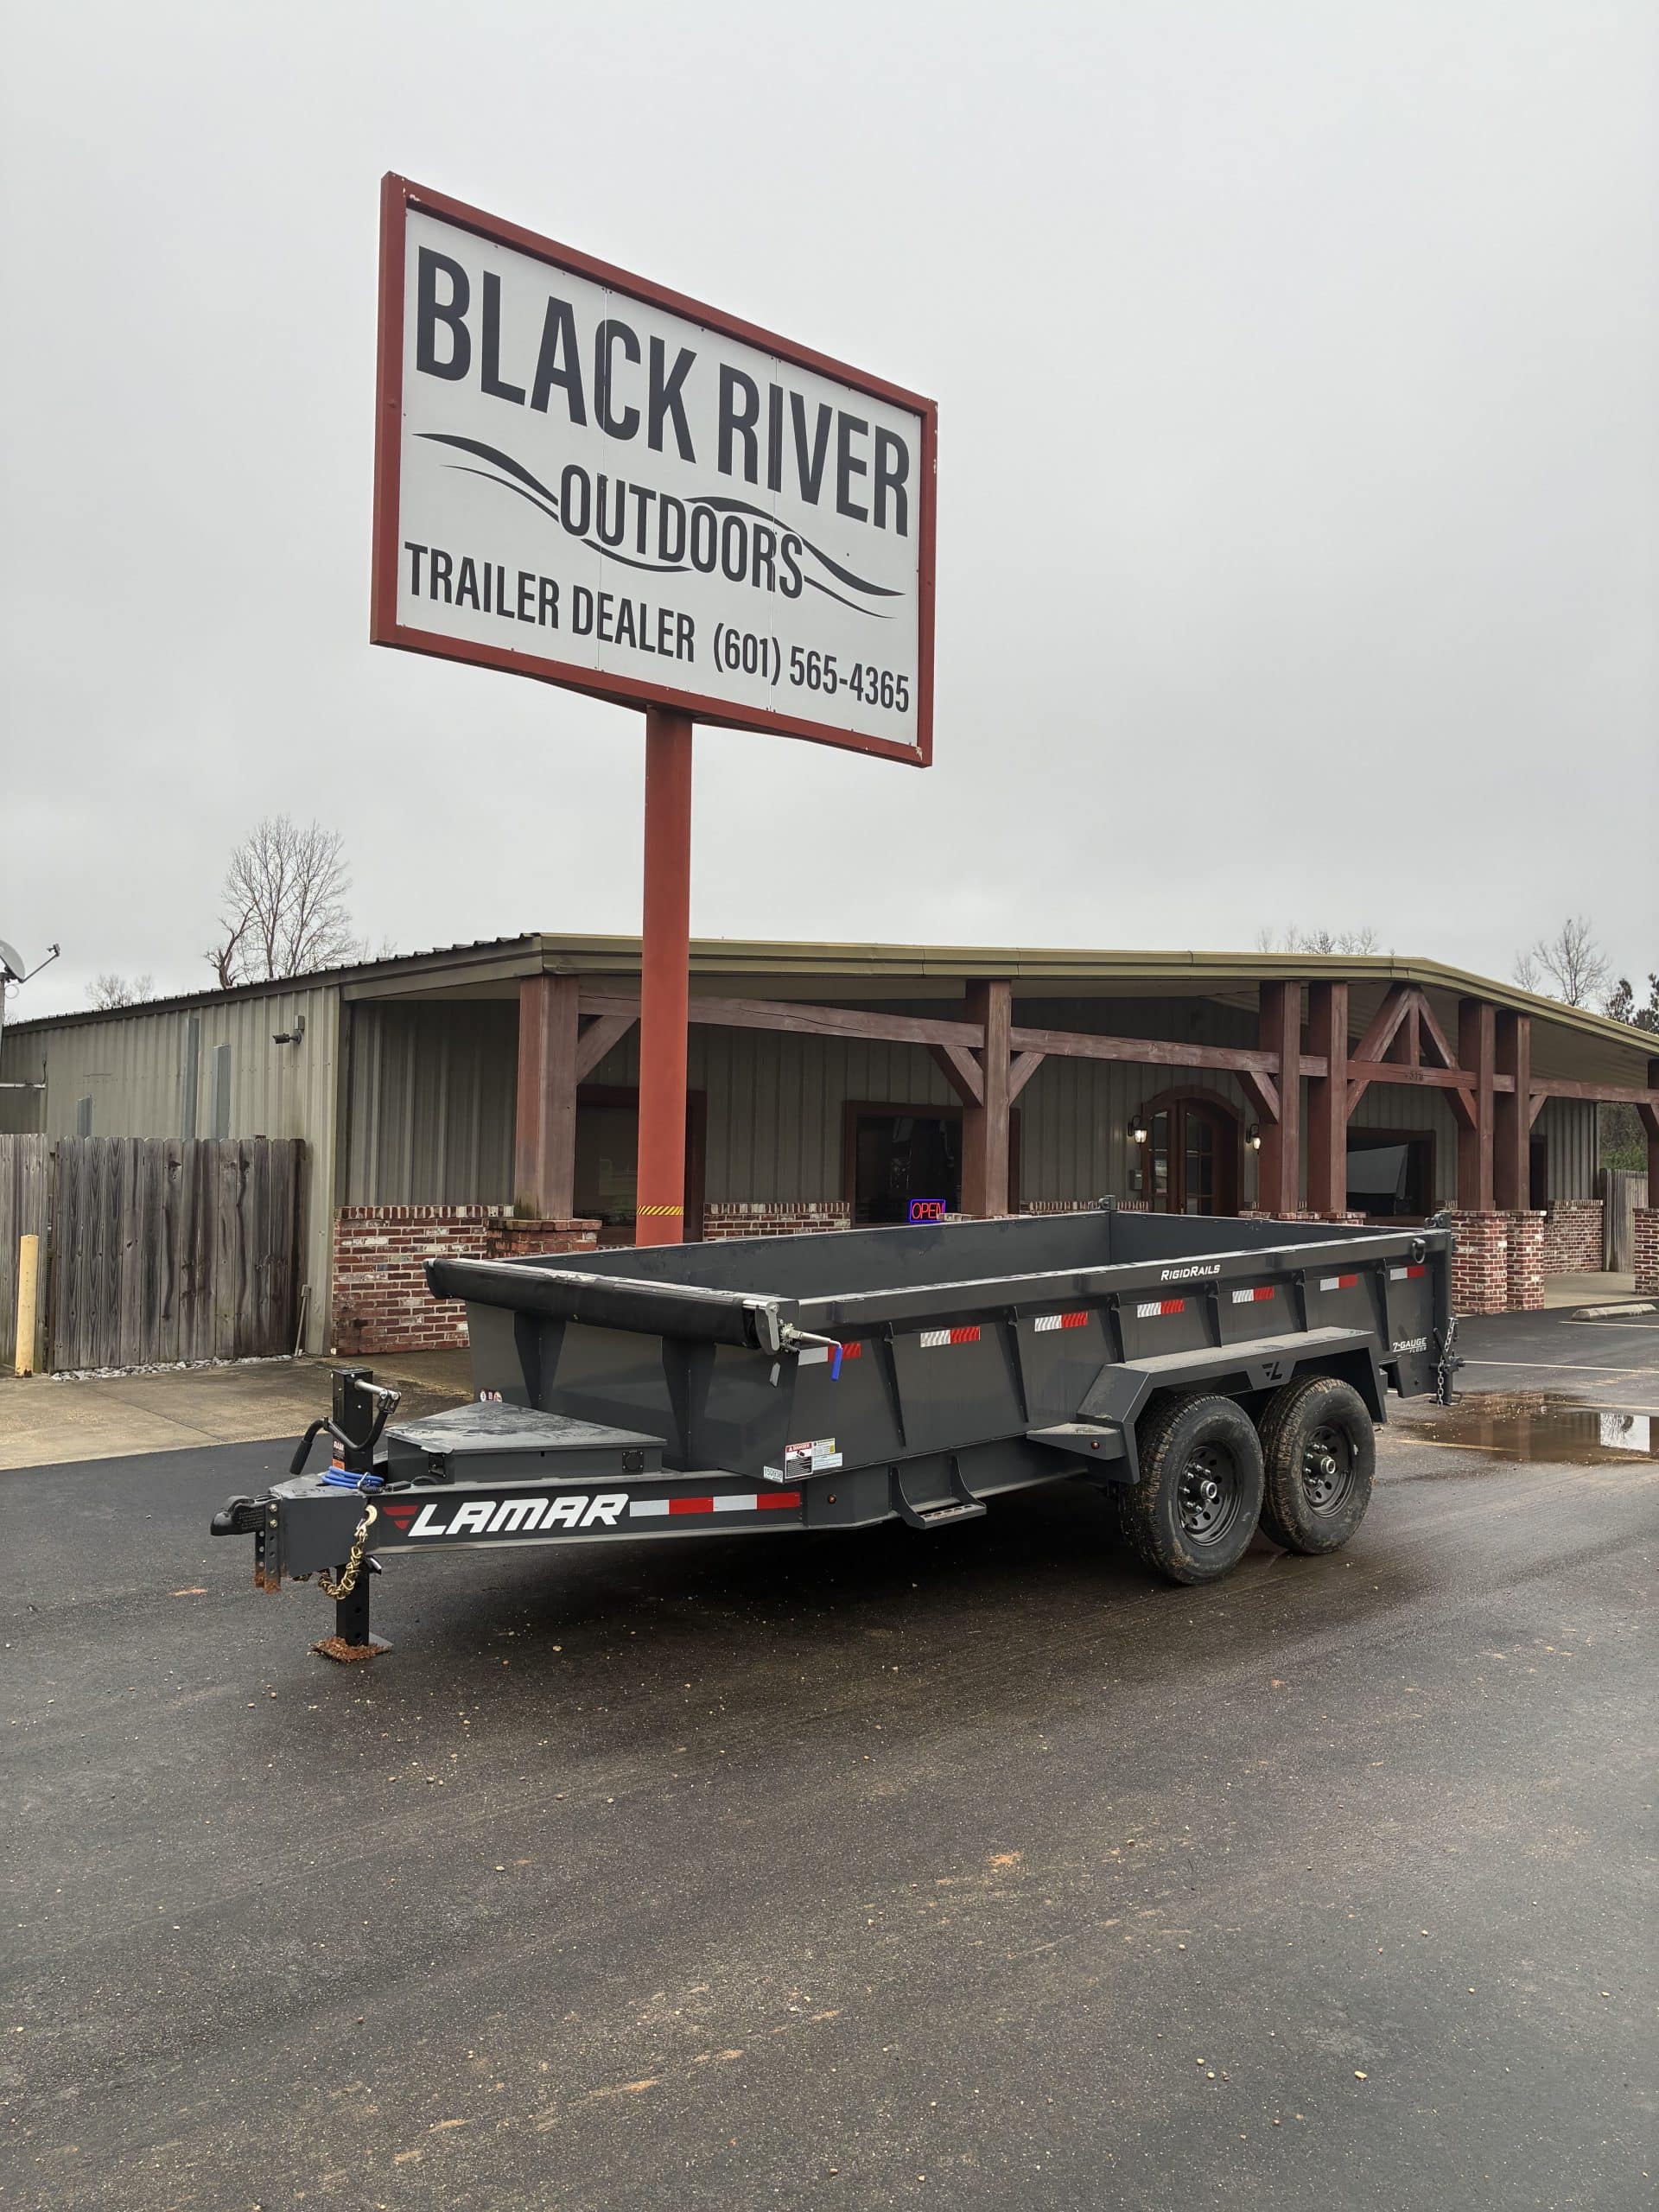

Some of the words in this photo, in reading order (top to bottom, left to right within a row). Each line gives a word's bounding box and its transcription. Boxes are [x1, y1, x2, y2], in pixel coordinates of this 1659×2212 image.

[416, 245, 697, 464] BLACK
[717, 362, 910, 538] RIVER
[559, 463, 804, 601] OUTDOORS
[404, 541, 560, 630] TRAILER
[572, 584, 696, 664] DEALER
[713, 622, 781, 686] (601)
[789, 645, 909, 713] 565-4365
[912, 1202, 944, 1219] OPEN
[407, 1493, 629, 1537] LAMAR
